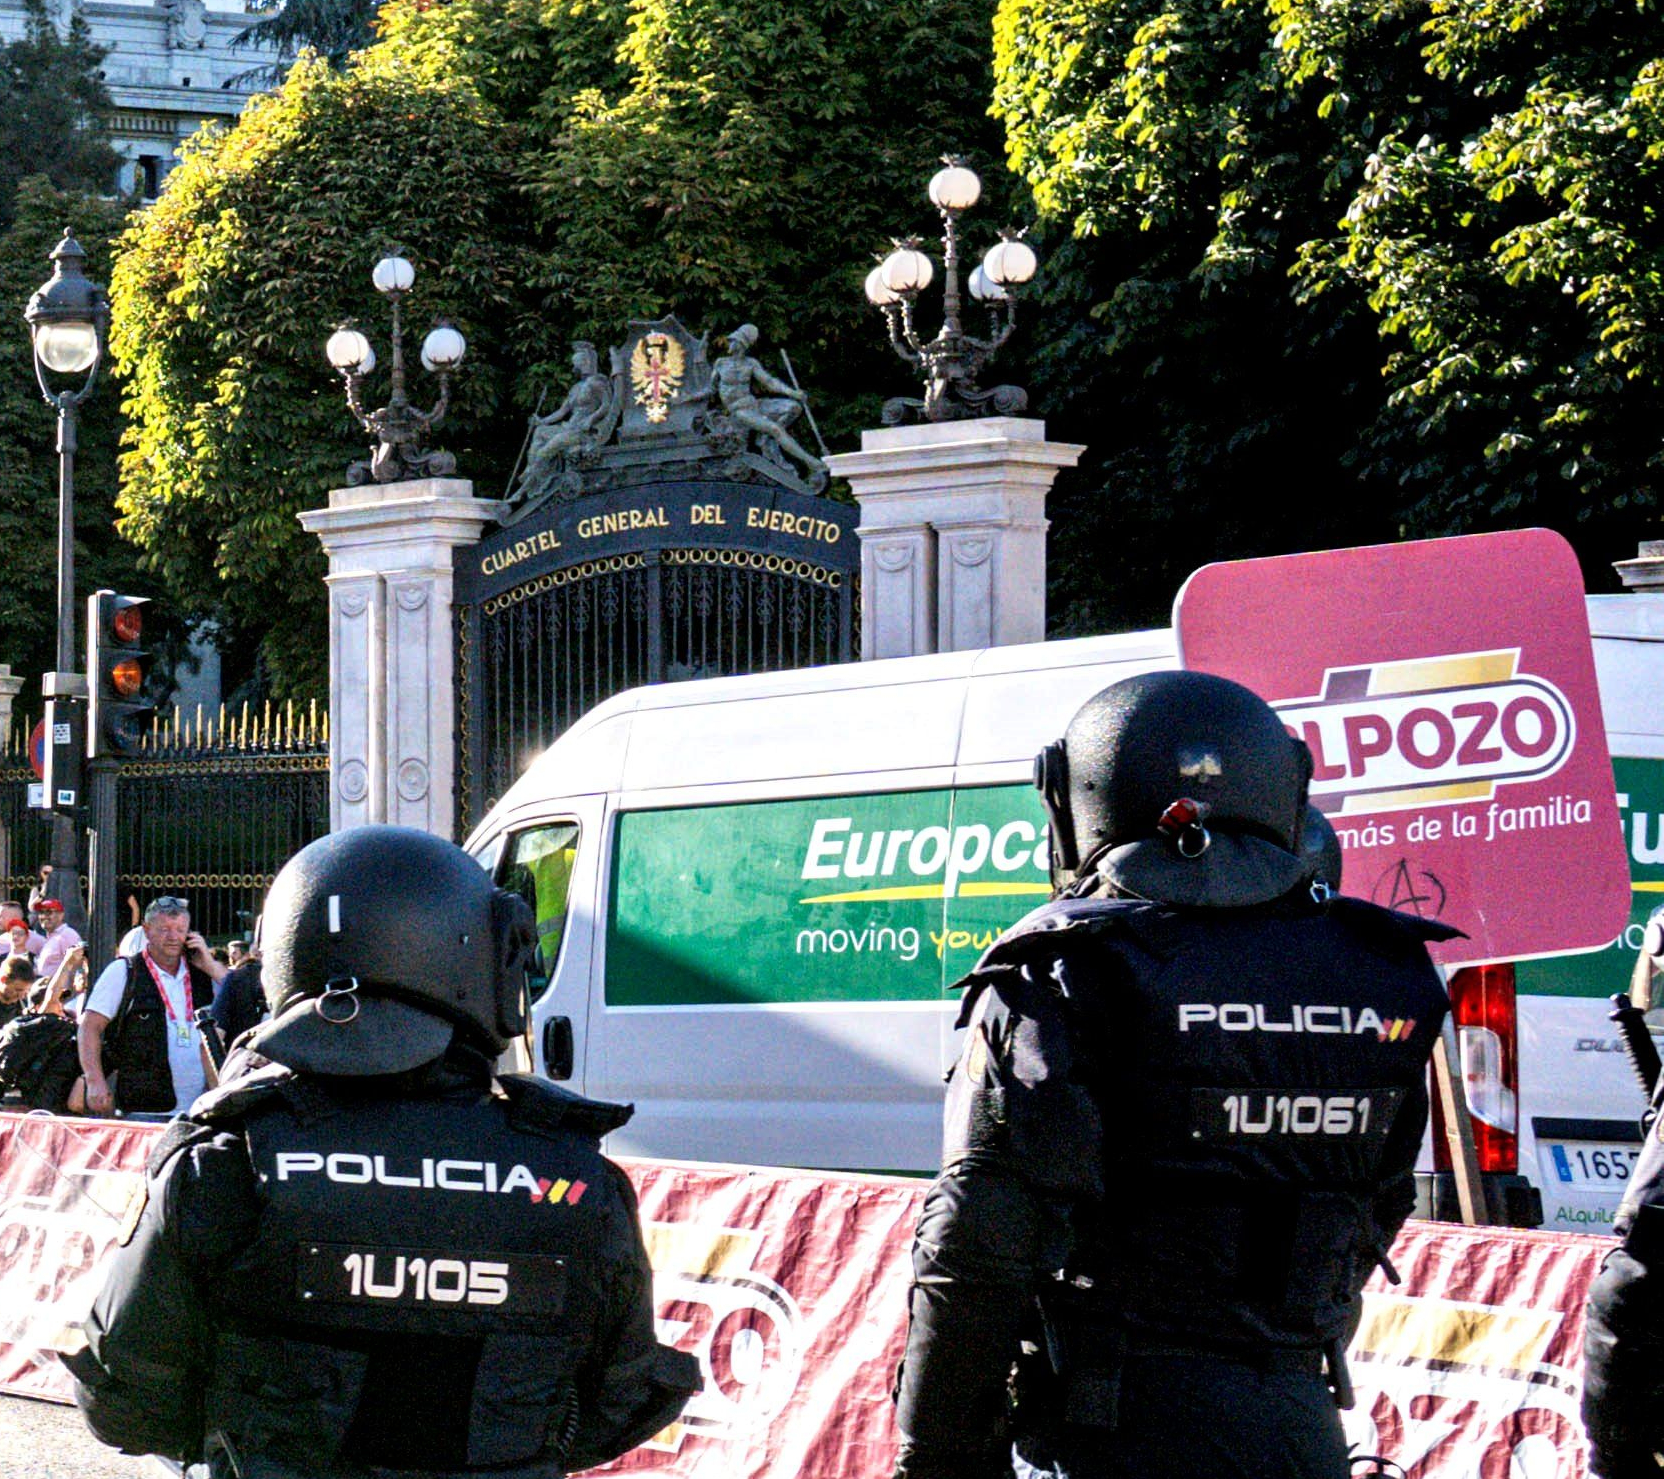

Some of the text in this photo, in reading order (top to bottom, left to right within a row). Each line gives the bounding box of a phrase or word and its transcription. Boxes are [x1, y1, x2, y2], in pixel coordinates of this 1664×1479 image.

[481, 504, 841, 576] CUARTEL GENERAL DEL EJERCITO
[1405, 815, 1442, 843] de
[1451, 810, 1477, 838] la
[1484, 794, 1592, 842] familia
[795, 921, 920, 961] moving
[1178, 1003, 1388, 1035] POLICIA
[1222, 1095, 1371, 1135] 1U1061
[275, 1151, 543, 1196] POLICIA
[343, 1253, 510, 1305] 1U105
